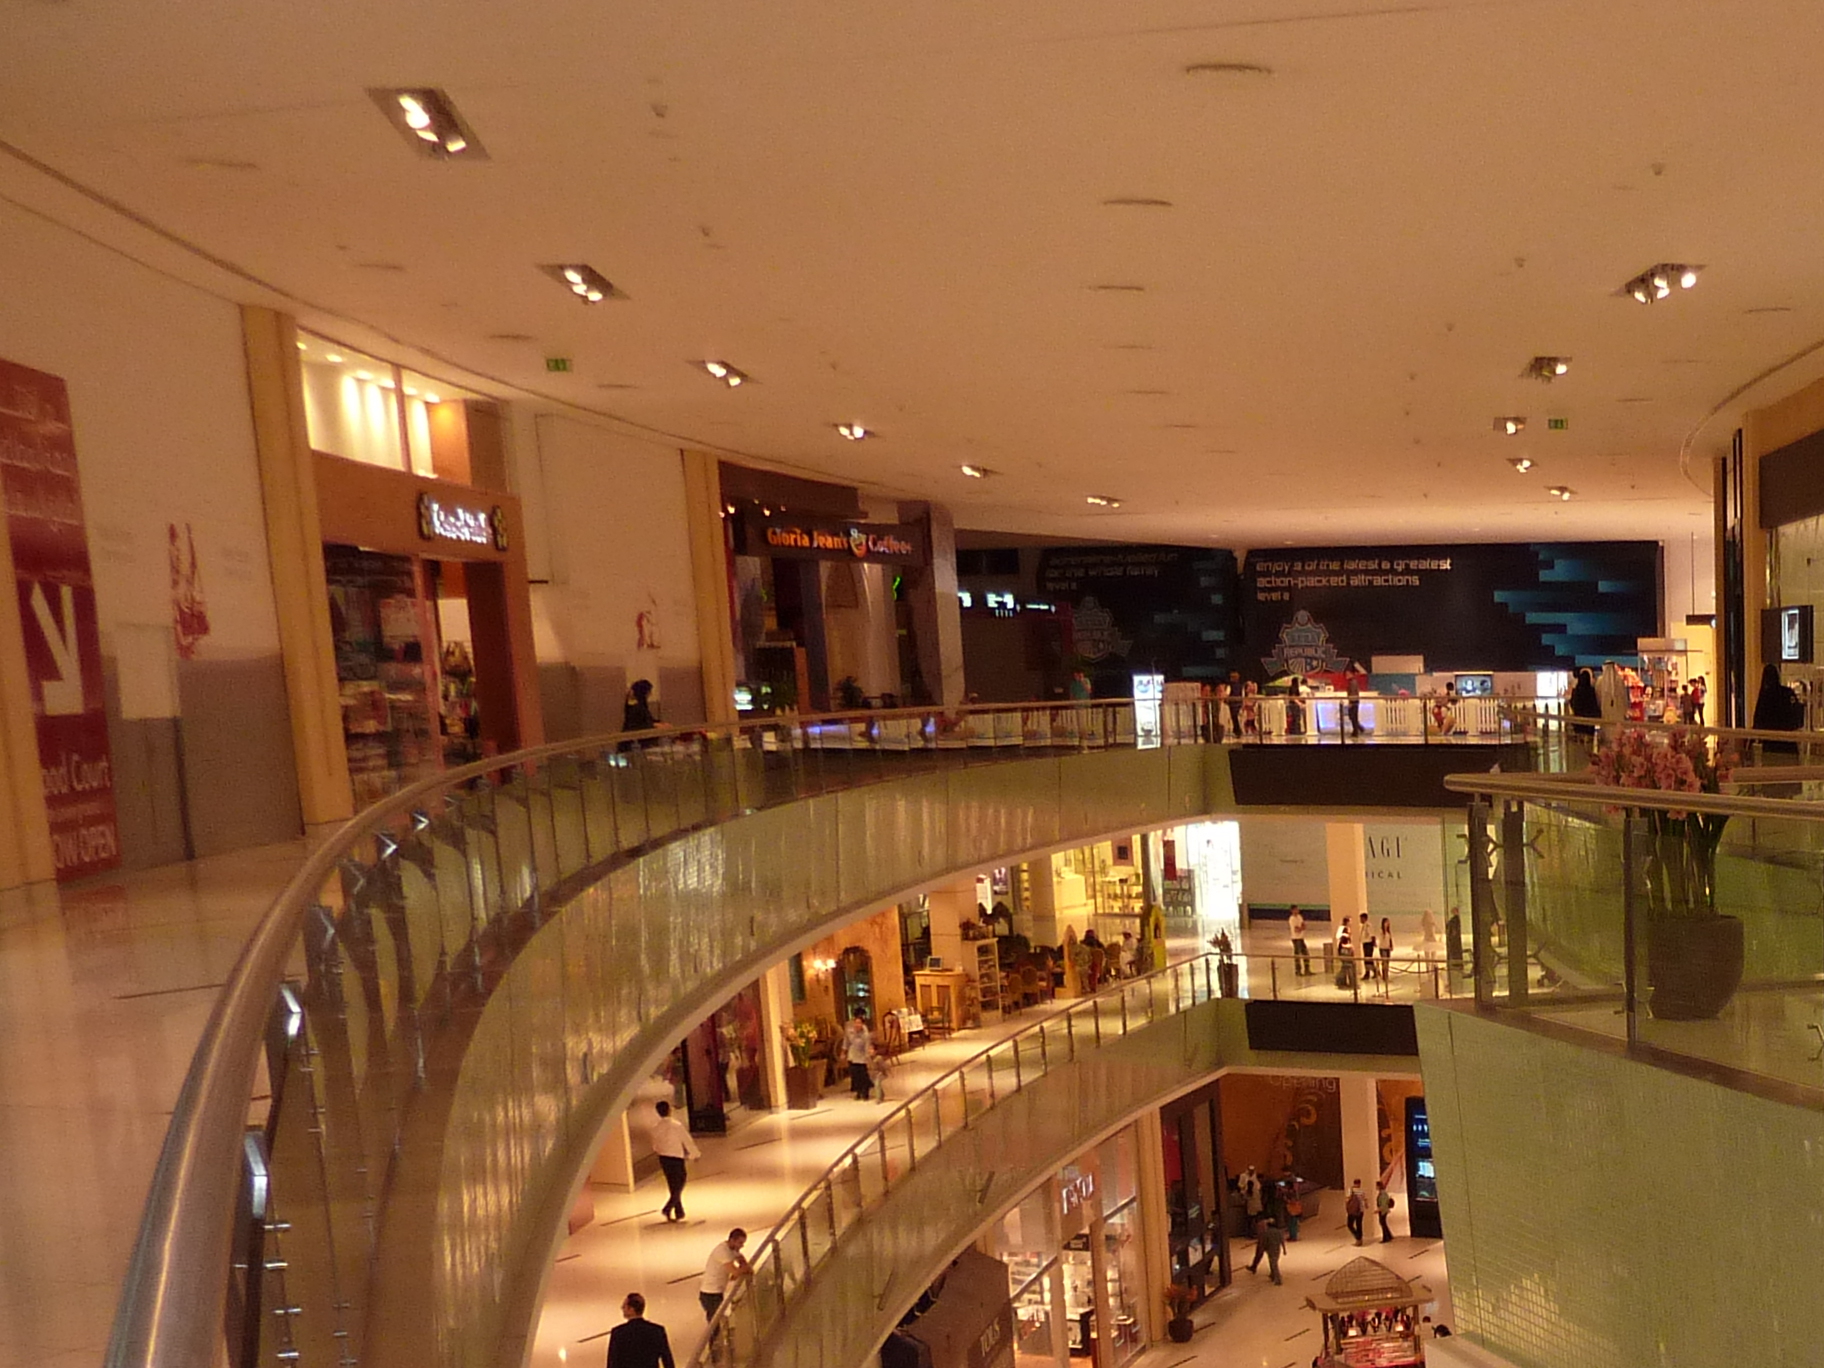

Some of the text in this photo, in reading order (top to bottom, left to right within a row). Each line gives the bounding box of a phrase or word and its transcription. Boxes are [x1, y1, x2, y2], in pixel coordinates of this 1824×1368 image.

[767, 527, 810, 547] Gloria
[1126, 565, 1159, 578] family
[1257, 561, 1291, 574] enjoy
[1304, 560, 1318, 571] of
[1319, 560, 1341, 571] the
[1343, 559, 1379, 571] latest
[1393, 557, 1452, 572] greatest
[1256, 574, 1420, 589] action-packed attractions
[1257, 591, 1281, 601] level
[1283, 647, 1326, 658] REPUBLIC
[71, 753, 111, 792] Court
